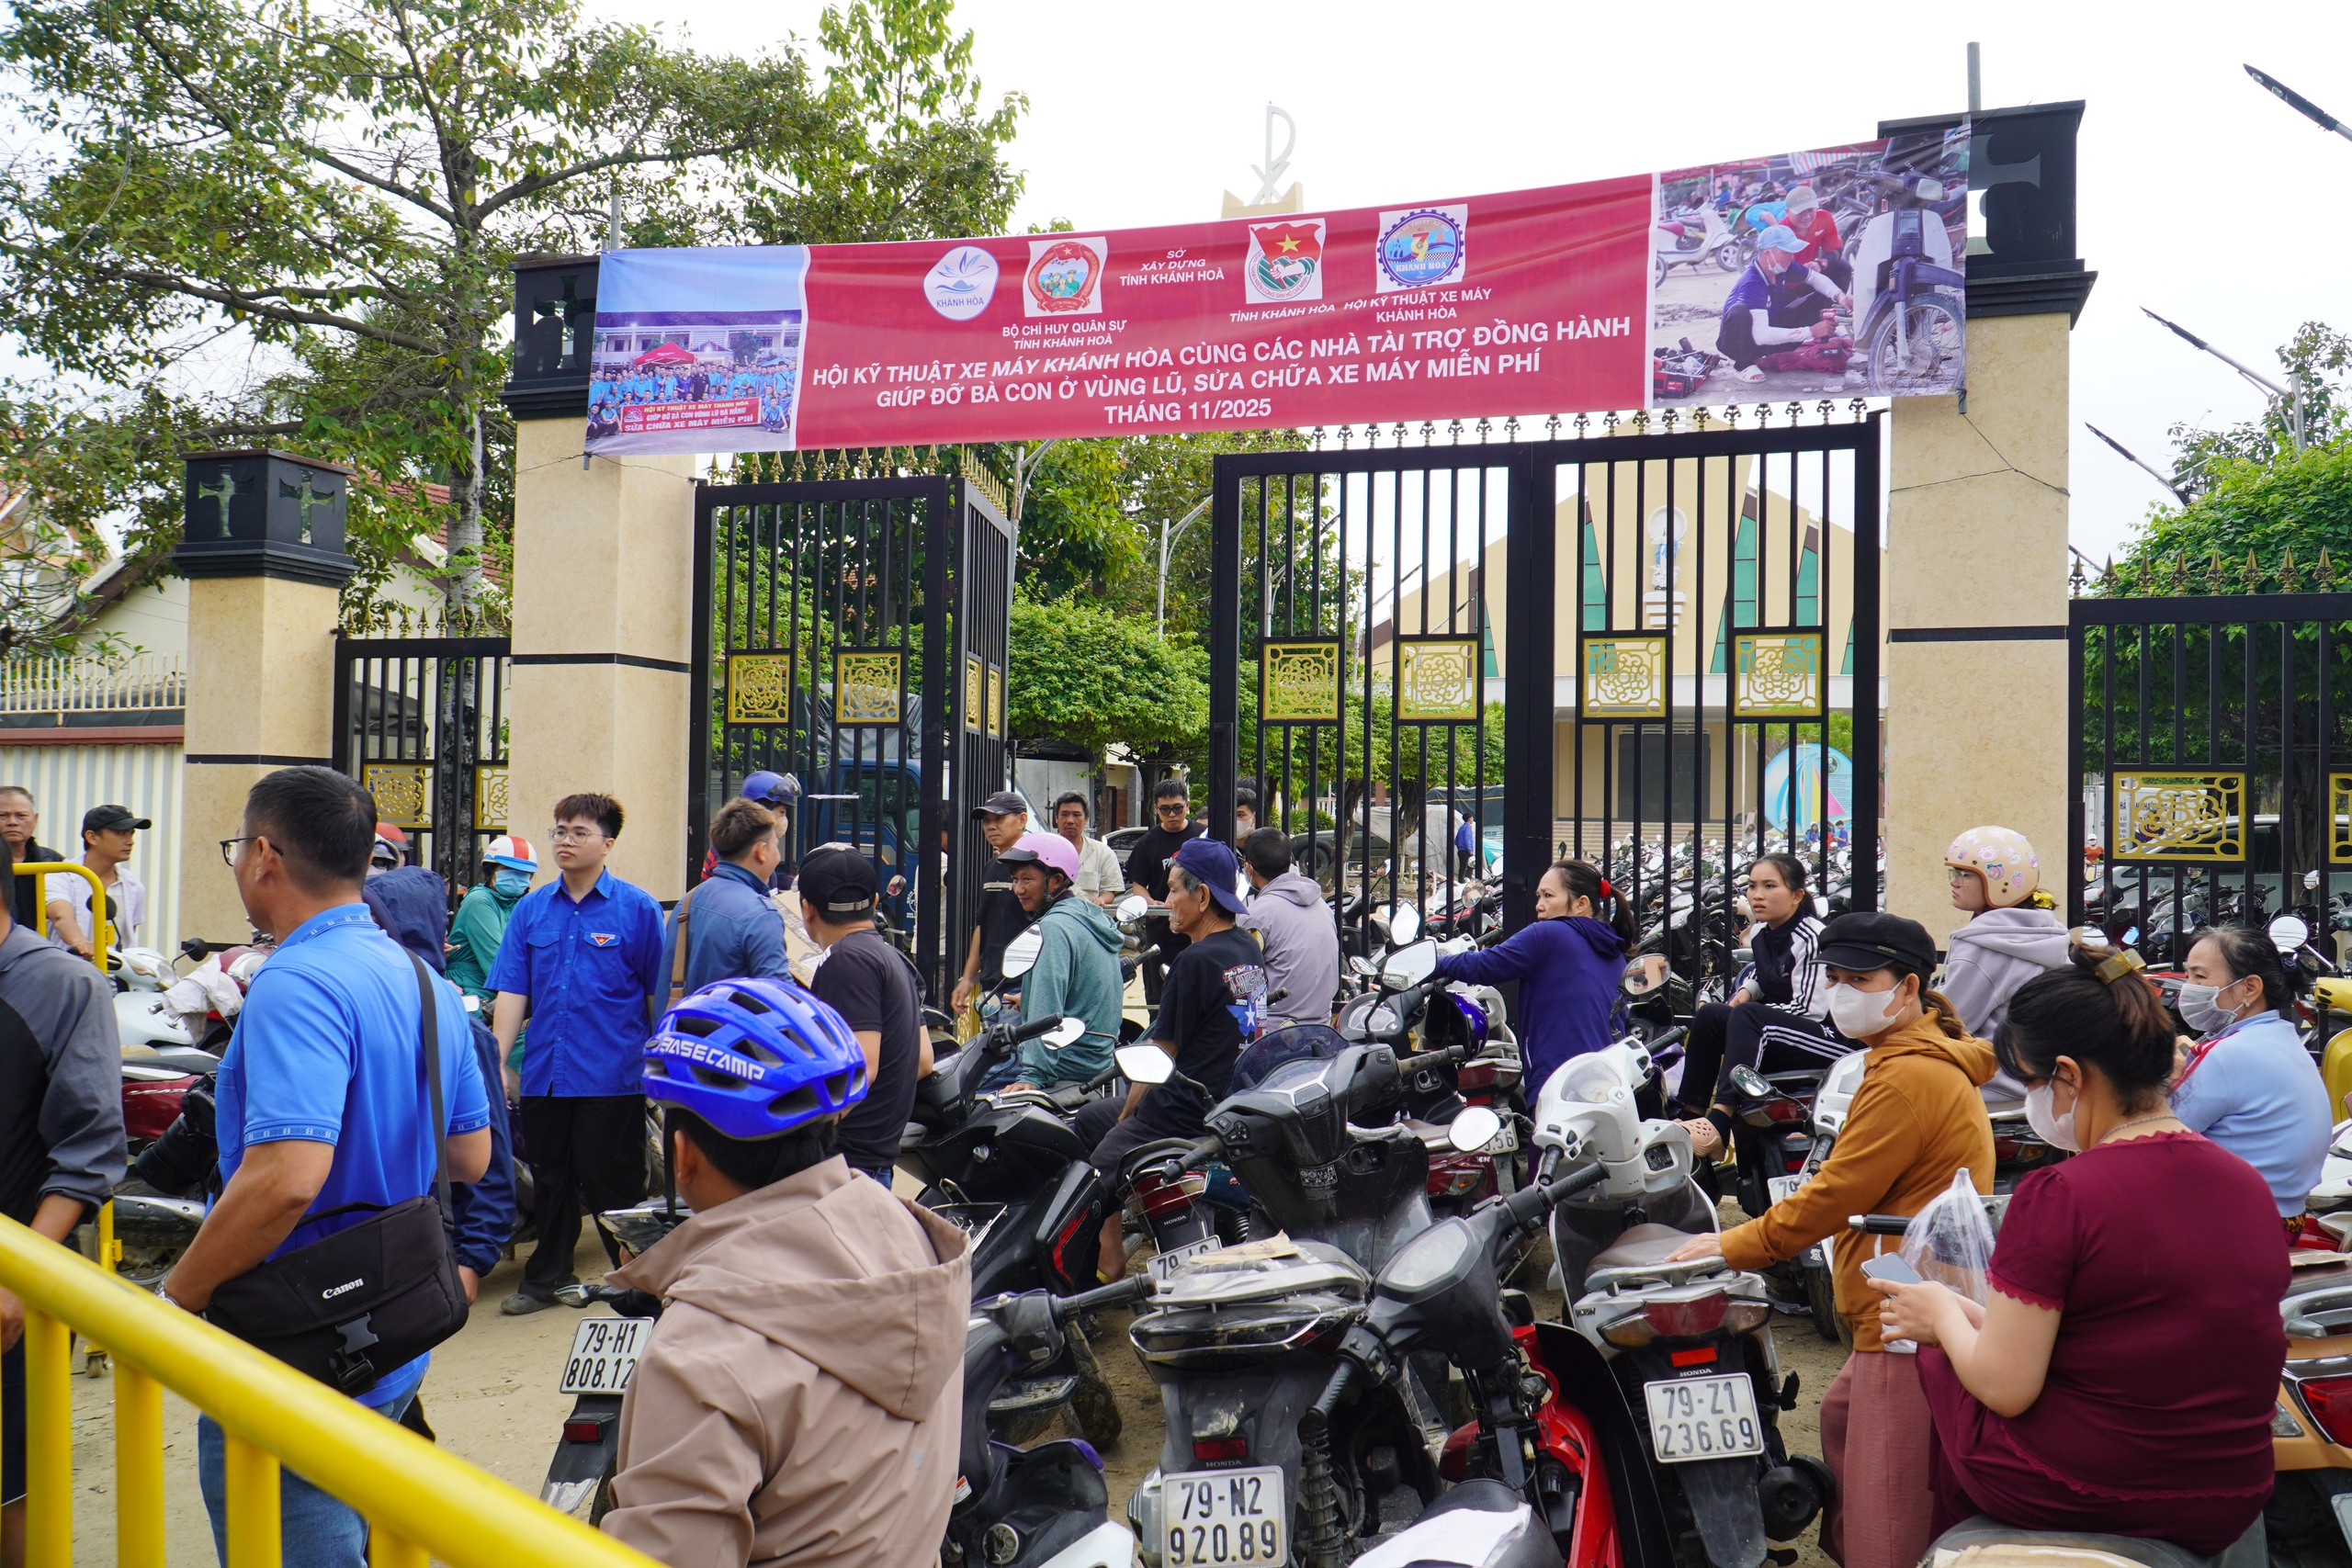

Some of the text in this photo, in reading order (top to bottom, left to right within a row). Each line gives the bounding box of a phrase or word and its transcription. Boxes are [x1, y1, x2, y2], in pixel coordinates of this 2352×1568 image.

[1167, 247, 1187, 259] SỞ
[1140, 258, 1206, 272] XÂY DỰNG
[1119, 266, 1225, 287] TỈNH KHÁNH HOÀ
[936, 296, 984, 308] KHÁNH HÒA
[1344, 287, 1492, 310] HỘI KỸ THUẬT XE MÁY
[1229, 303, 1336, 323] TỈNH KHÁNH HÒA
[1376, 305, 1457, 323] KHÁNH HÒA
[1002, 319, 1128, 338] BỘ CHỈ HUY QUÂN SỰ
[812, 314, 1631, 389] HỘI KỸ THUẬT XE MÁY KHÁNH HÒA CÙNG CÁC NHÀ TÀI TRỢ ĐỒNG HÀNH
[1013, 334, 1113, 350] TỈNH KHÁNH HOÀ
[876, 347, 1542, 408] GIÚP ĐỠ BÀ CON Ở VÙNG LŨ, SỬA CHỮA XE MÁY MIỄN PHÍ
[1103, 397, 1272, 424] THÁNG 11/2025
[625, 421, 643, 432] SỬA
[647, 419, 672, 431] CHỮA
[689, 417, 709, 427] MÁY
[1163, 1214, 1187, 1226] HONDA
[322, 1278, 364, 1300] Canon
[582, 1323, 639, 1354] 79-H1
[566, 1358, 637, 1389] 808.12
[1679, 1368, 1713, 1377] HONDA
[1663, 1382, 1736, 1418] 79-Z1
[1659, 1416, 1756, 1455] 236.69
[1205, 1460, 1242, 1468] HONDA
[1181, 1476, 1263, 1520] 79-N2
[1170, 1519, 1277, 1566] 920.89
